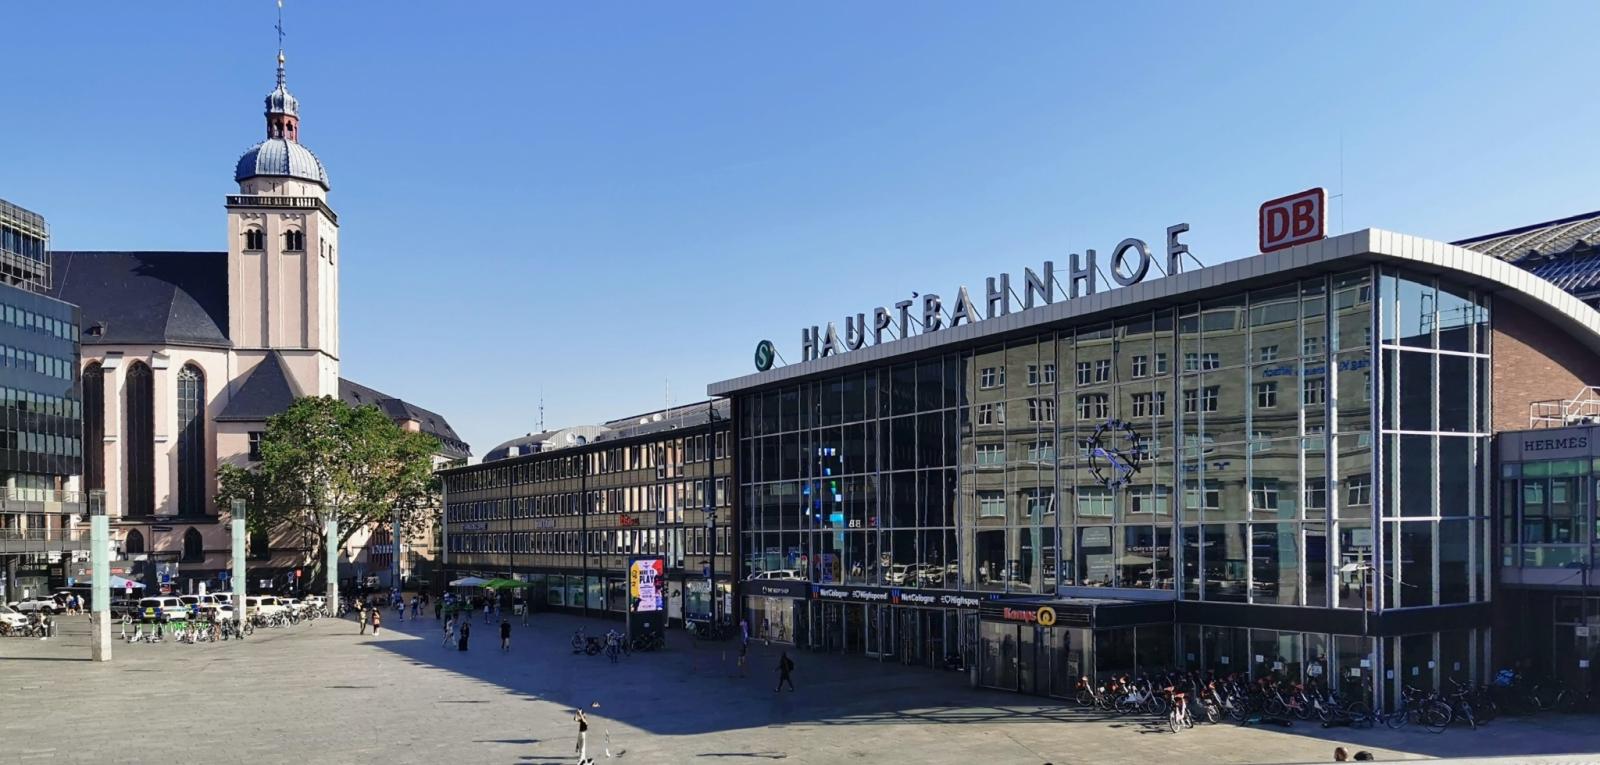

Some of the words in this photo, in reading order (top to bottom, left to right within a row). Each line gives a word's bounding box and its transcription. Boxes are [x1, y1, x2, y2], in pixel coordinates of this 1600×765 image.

[1267, 199, 1315, 243] DB
[801, 222, 1190, 362] HAUPTBAHNHOF
[756, 343, 769, 369] S
[639, 575, 654, 584] PLAY
[820, 588, 849, 599] NetCologne
[901, 593, 935, 604] NetCologne
[951, 595, 979, 607] Highspee
[1003, 607, 1036, 623] Kamps
